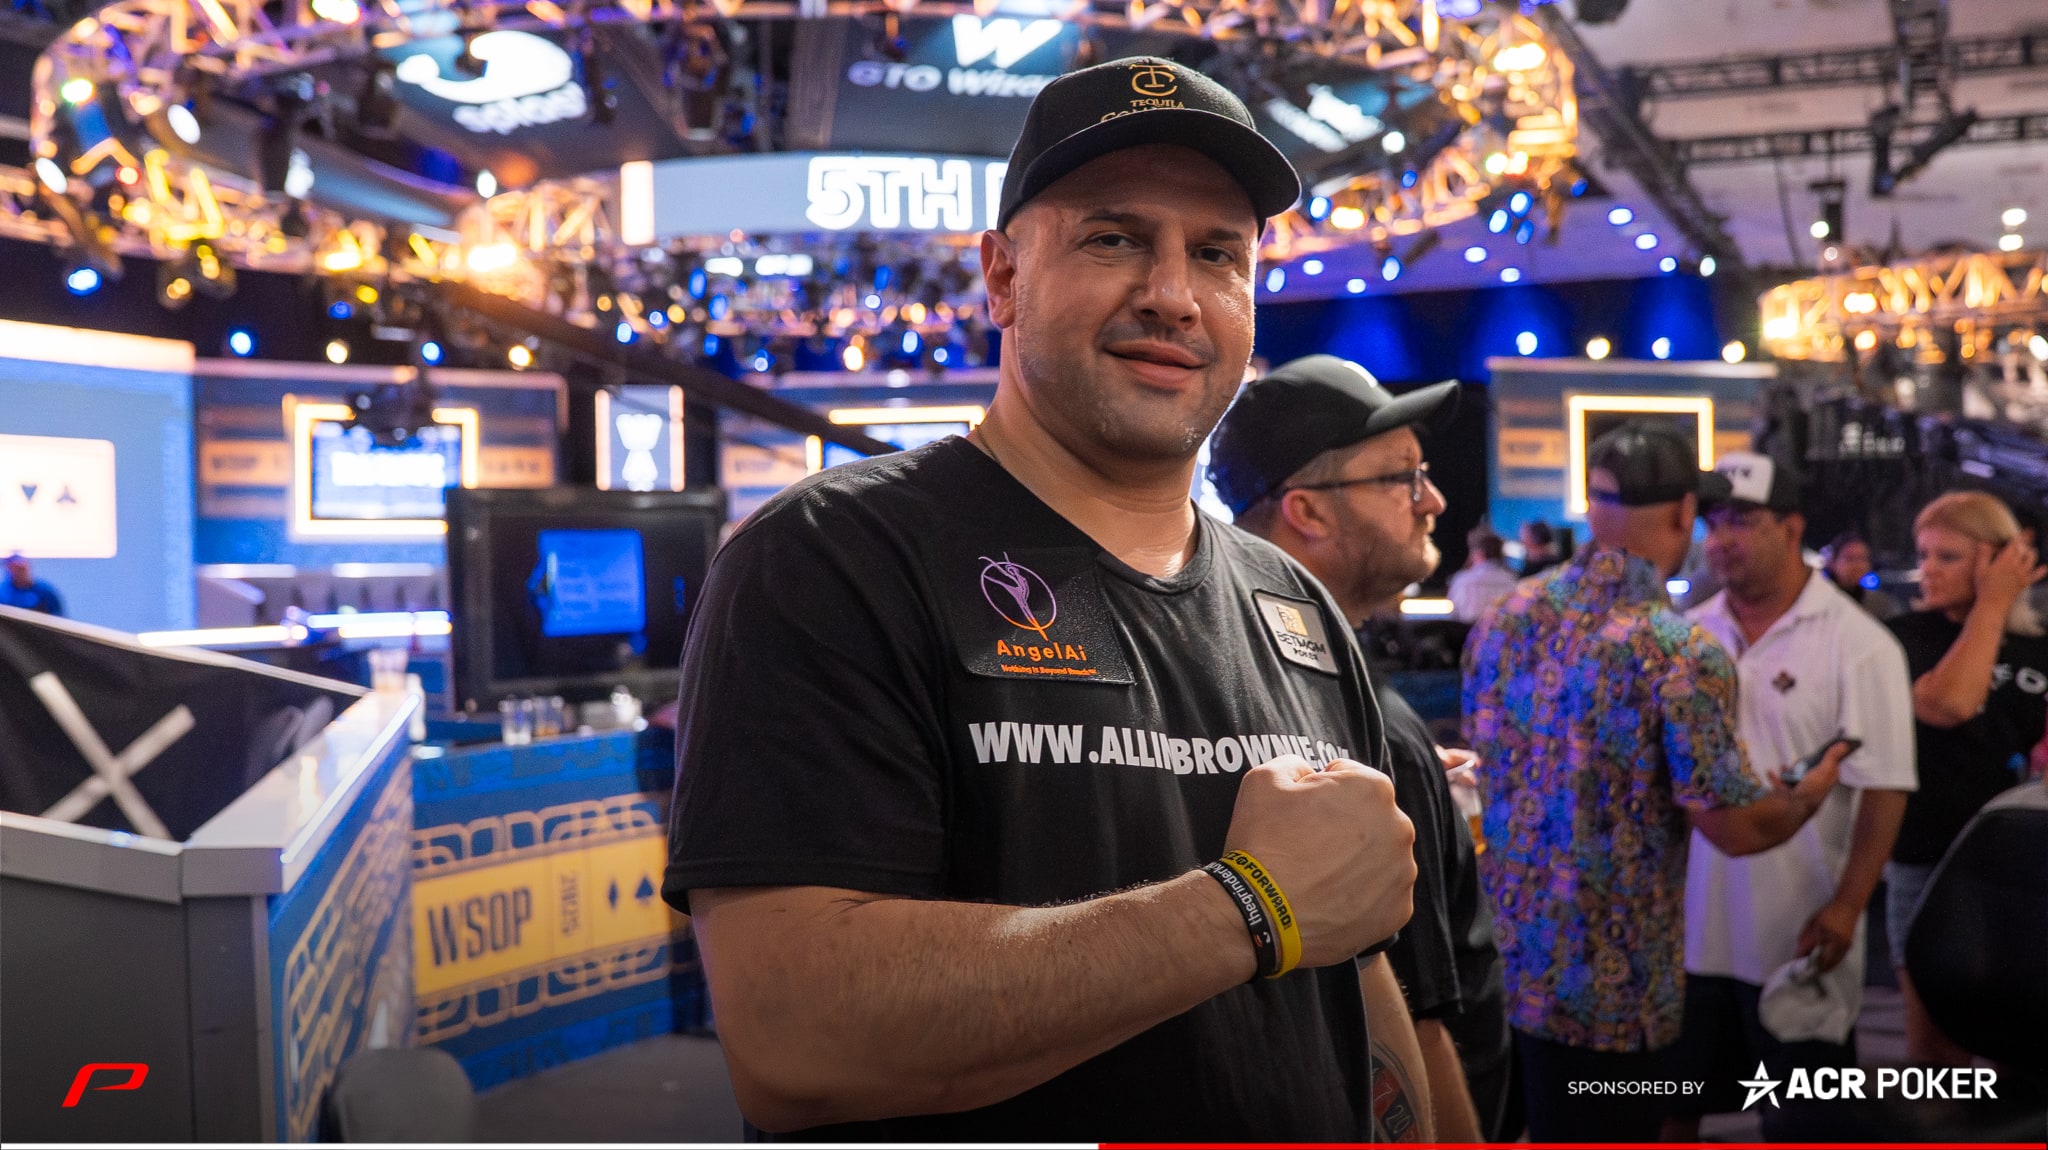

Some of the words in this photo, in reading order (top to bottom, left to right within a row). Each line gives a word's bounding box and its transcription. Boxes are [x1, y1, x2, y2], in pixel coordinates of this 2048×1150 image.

[1129, 98, 1185, 109] TEQUILA
[806, 156, 973, 231] 5TH
[997, 639, 1088, 662] AngelAi
[427, 885, 533, 967] WSOP
